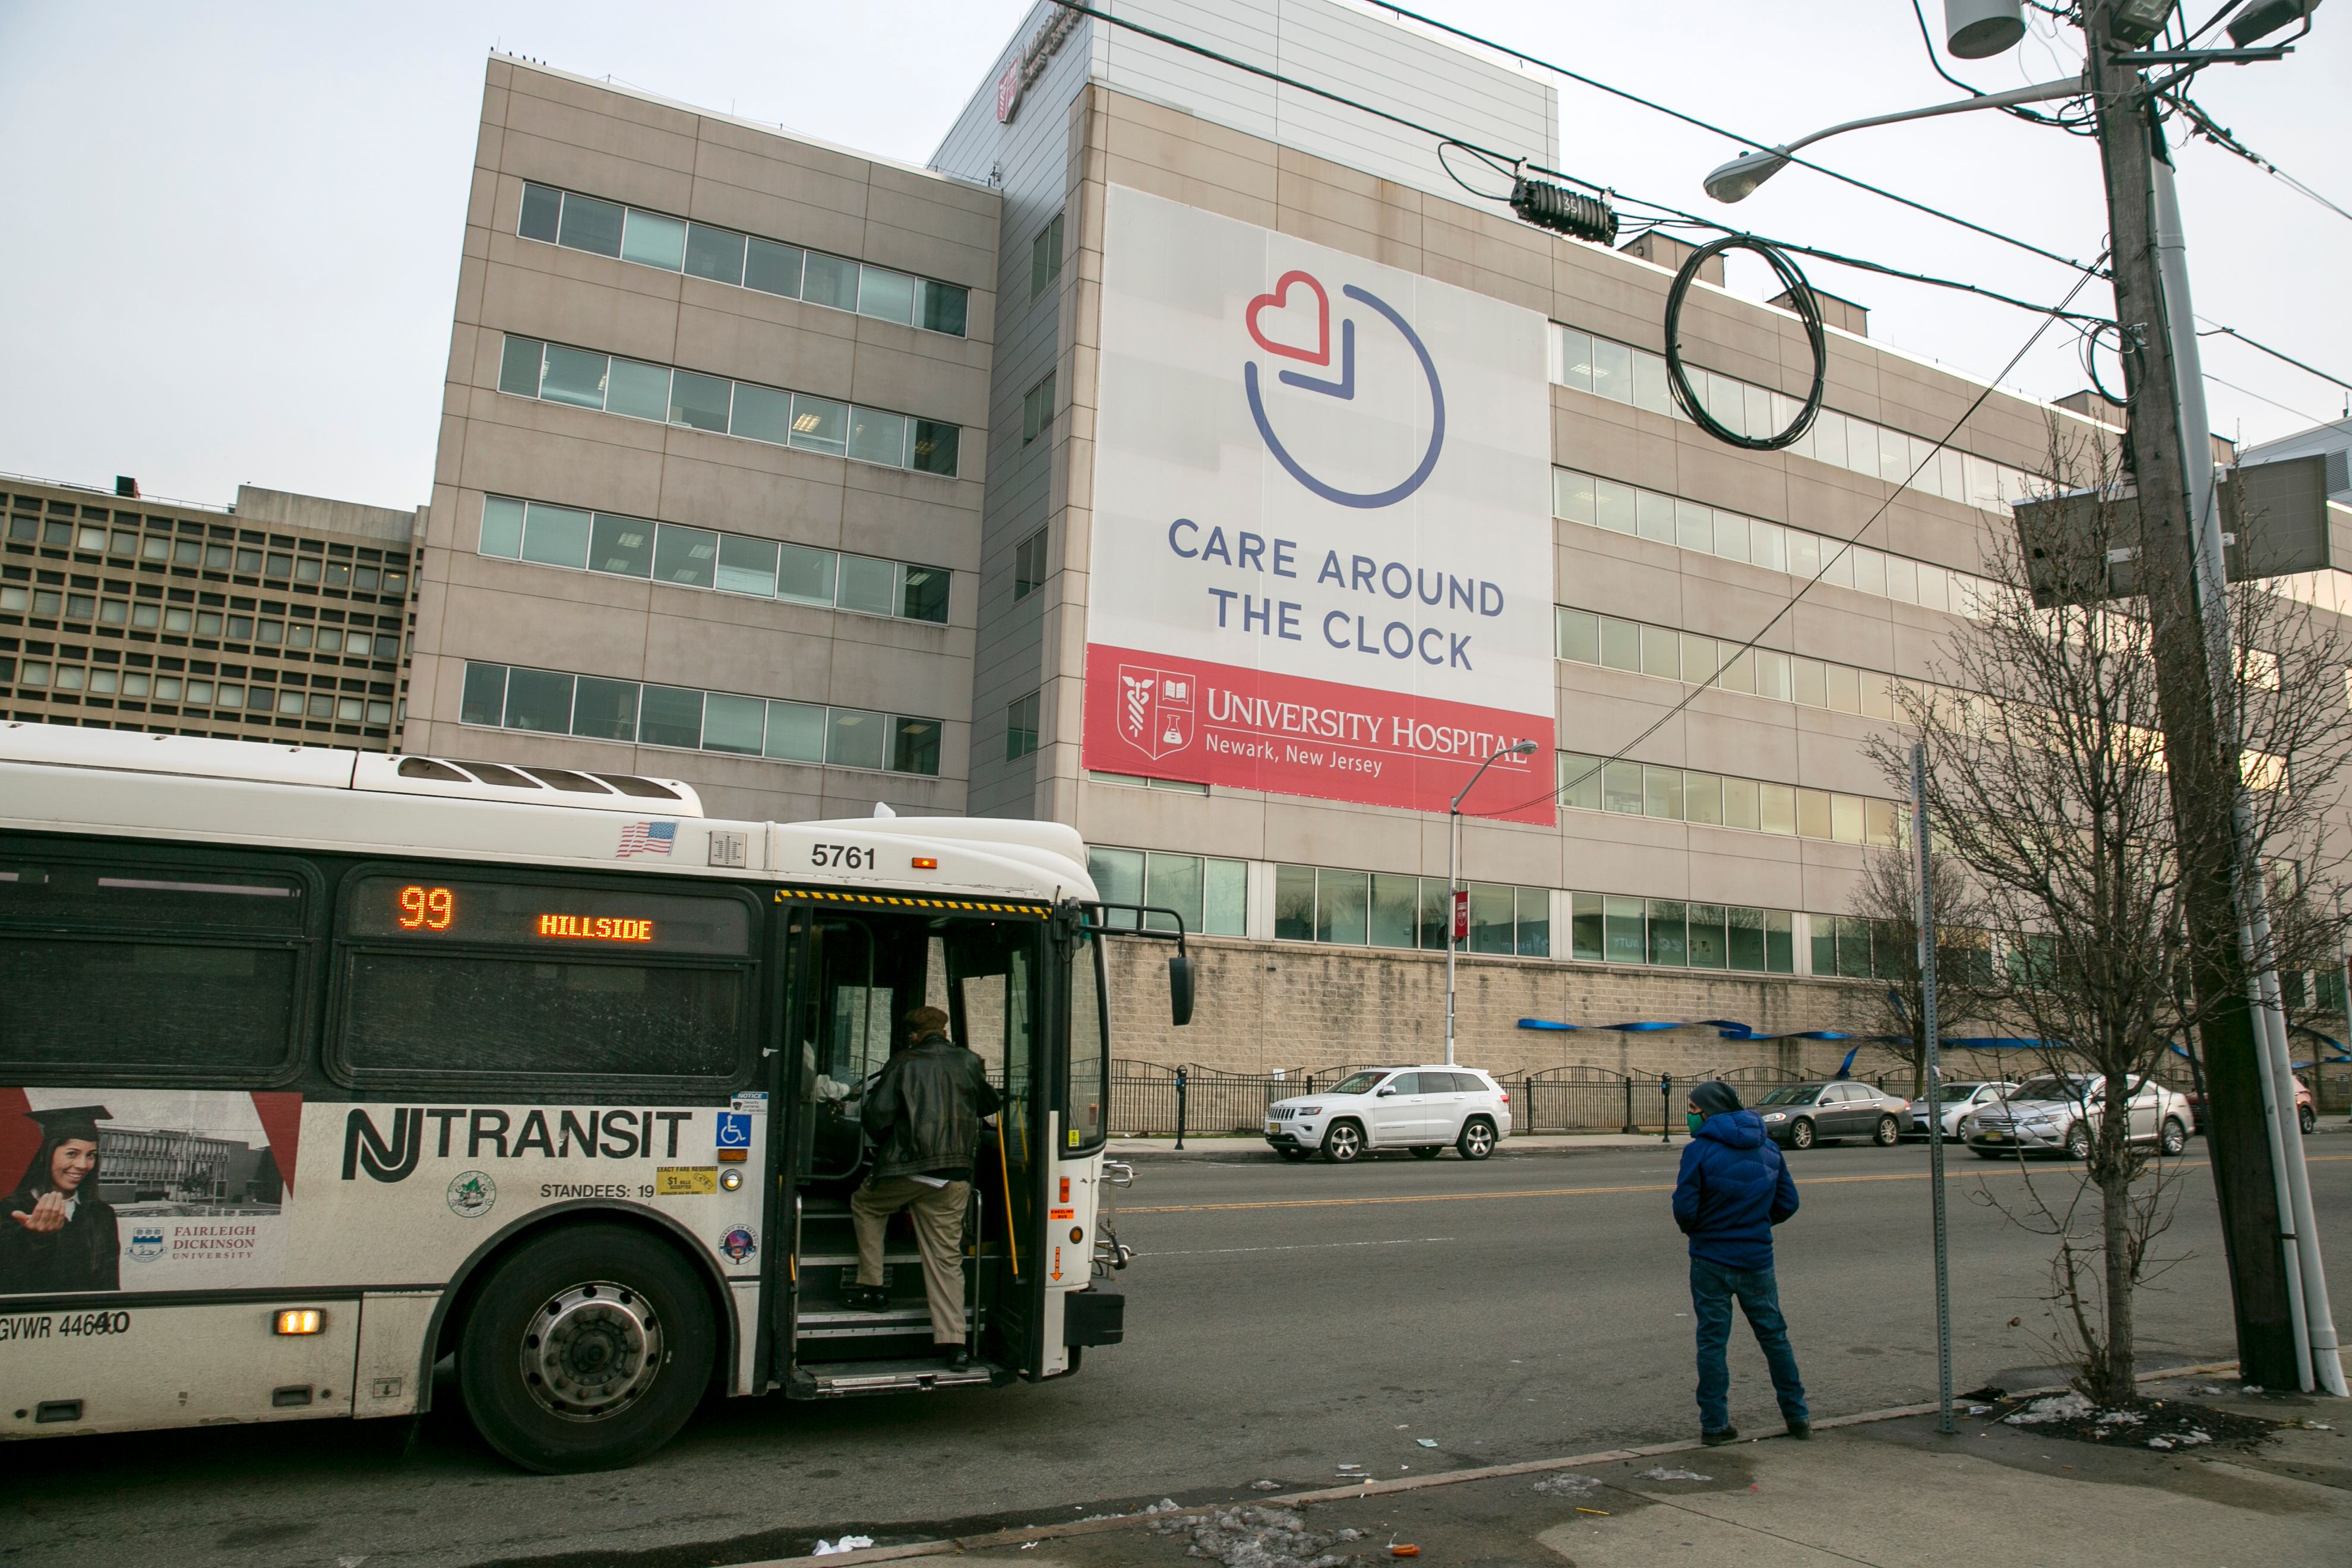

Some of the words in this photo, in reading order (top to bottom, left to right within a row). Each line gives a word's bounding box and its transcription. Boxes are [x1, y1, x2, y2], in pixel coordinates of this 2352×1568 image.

[1557, 194, 1582, 214] 1351
[1169, 519, 1297, 578] CARE
[1317, 549, 1504, 617] AROUND
[1209, 587, 1301, 641] THE
[1323, 611, 1473, 671] CLOCK
[1207, 687, 1384, 743] UNIVERSITY
[1392, 716, 1528, 764] HOSPITAL
[1206, 734, 1279, 763] Newark,
[1286, 745, 1324, 766] New
[1329, 751, 1383, 778] Jersey
[811, 843, 874, 870] 5761
[399, 886, 453, 929] 99
[540, 914, 652, 941] HILLSIDE
[341, 1108, 424, 1183] NJ
[426, 1108, 692, 1159] TRANSIT
[540, 1184, 630, 1197] STANDEES:
[637, 1184, 654, 1197] 19
[668, 1176, 677, 1185] $1
[173, 1239, 255, 1249] DICKINSON
[174, 1226, 256, 1236] FAIRLEIGH
[172, 1251, 253, 1260] UNIVERSITY
[0, 1316, 52, 1341] GVWR
